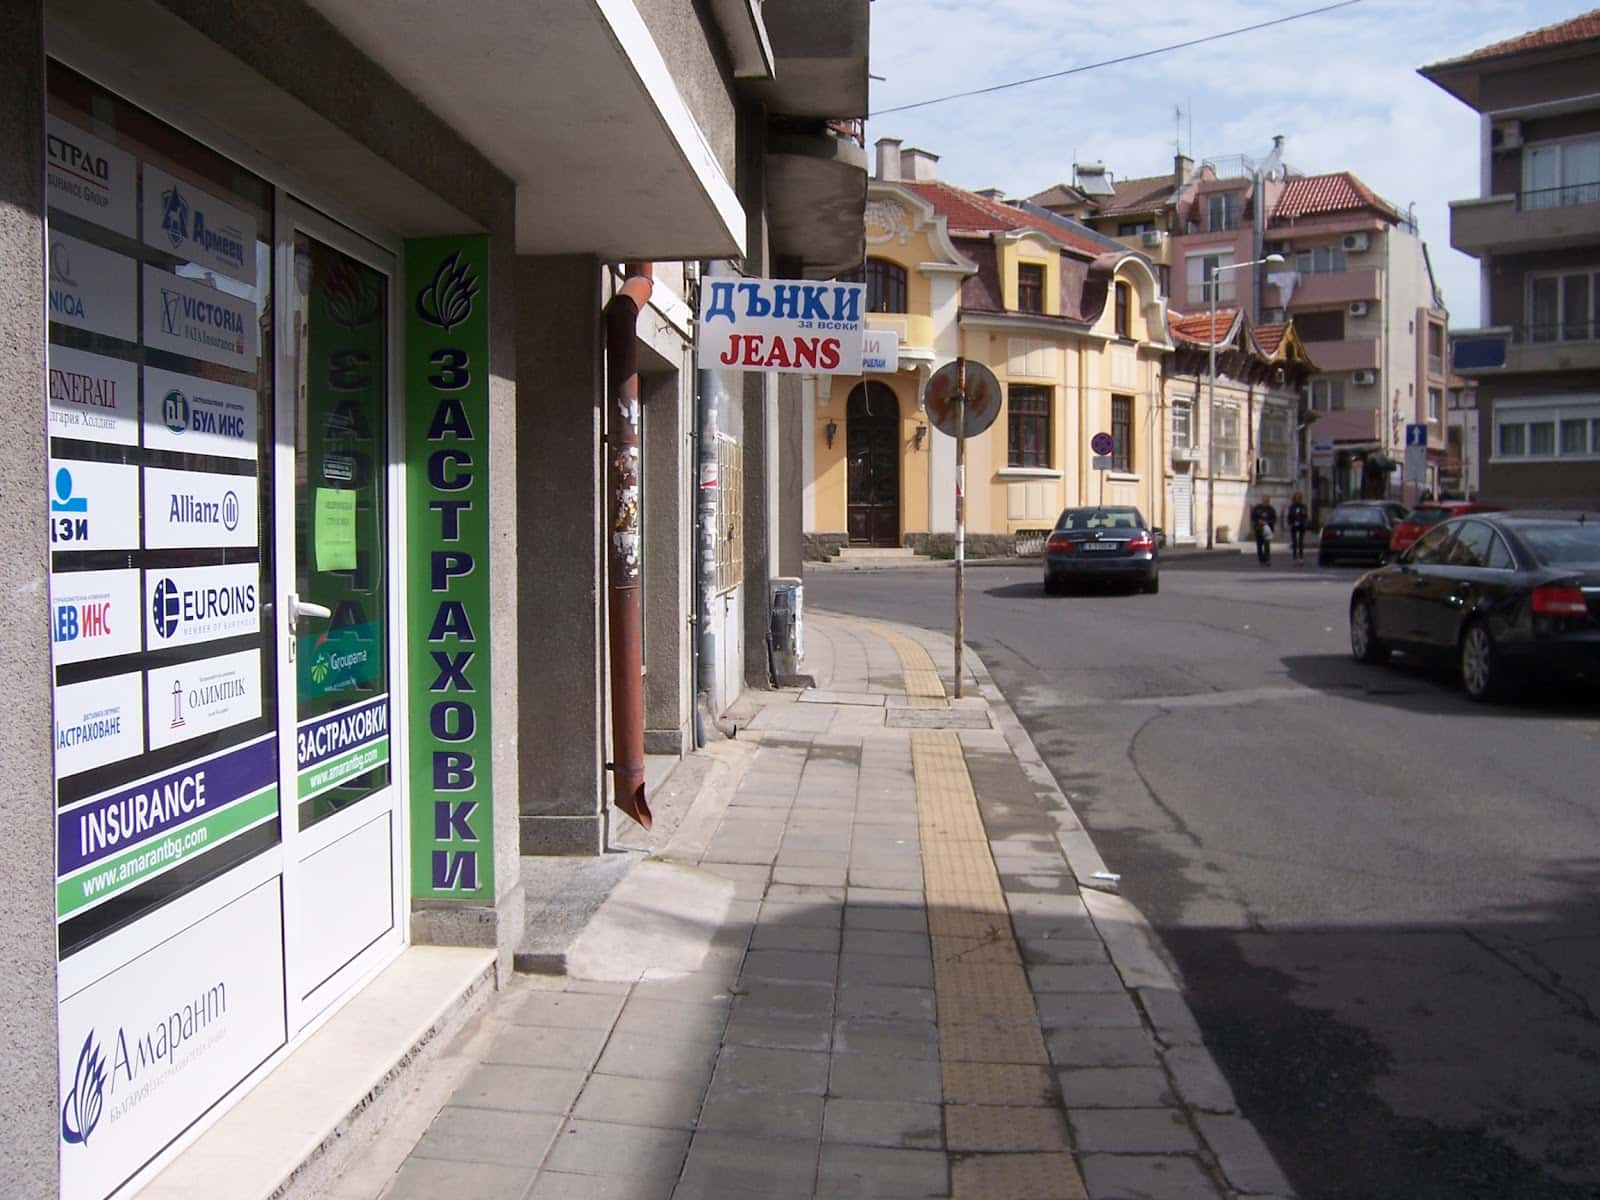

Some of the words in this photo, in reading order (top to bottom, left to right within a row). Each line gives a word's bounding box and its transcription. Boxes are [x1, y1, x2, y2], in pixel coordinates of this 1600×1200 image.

[183, 295, 244, 334] VICTORIA
[705, 281, 861, 324] ДЪНКИ
[797, 320, 813, 329] за
[818, 321, 858, 331] всеки
[720, 334, 841, 369] JEANS
[192, 410, 216, 435] БУЛ
[219, 414, 244, 438] ИНС
[169, 494, 219, 524] Allianz
[82, 602, 111, 638] ИНС
[183, 584, 255, 621] EUROINS
[427, 348, 482, 892] ЗАСТРАХОВКИ
[330, 650, 367, 671] Groupama
[189, 677, 246, 709] ОЛИМПИК
[57, 716, 120, 750] АСТРАХОВАНЕ
[298, 703, 387, 764] ЗАСТРАХОВКИ
[80, 771, 206, 857] INSURANCE
[82, 826, 208, 897] www.amarantbg.com
[110, 981, 226, 1096] Амарант
